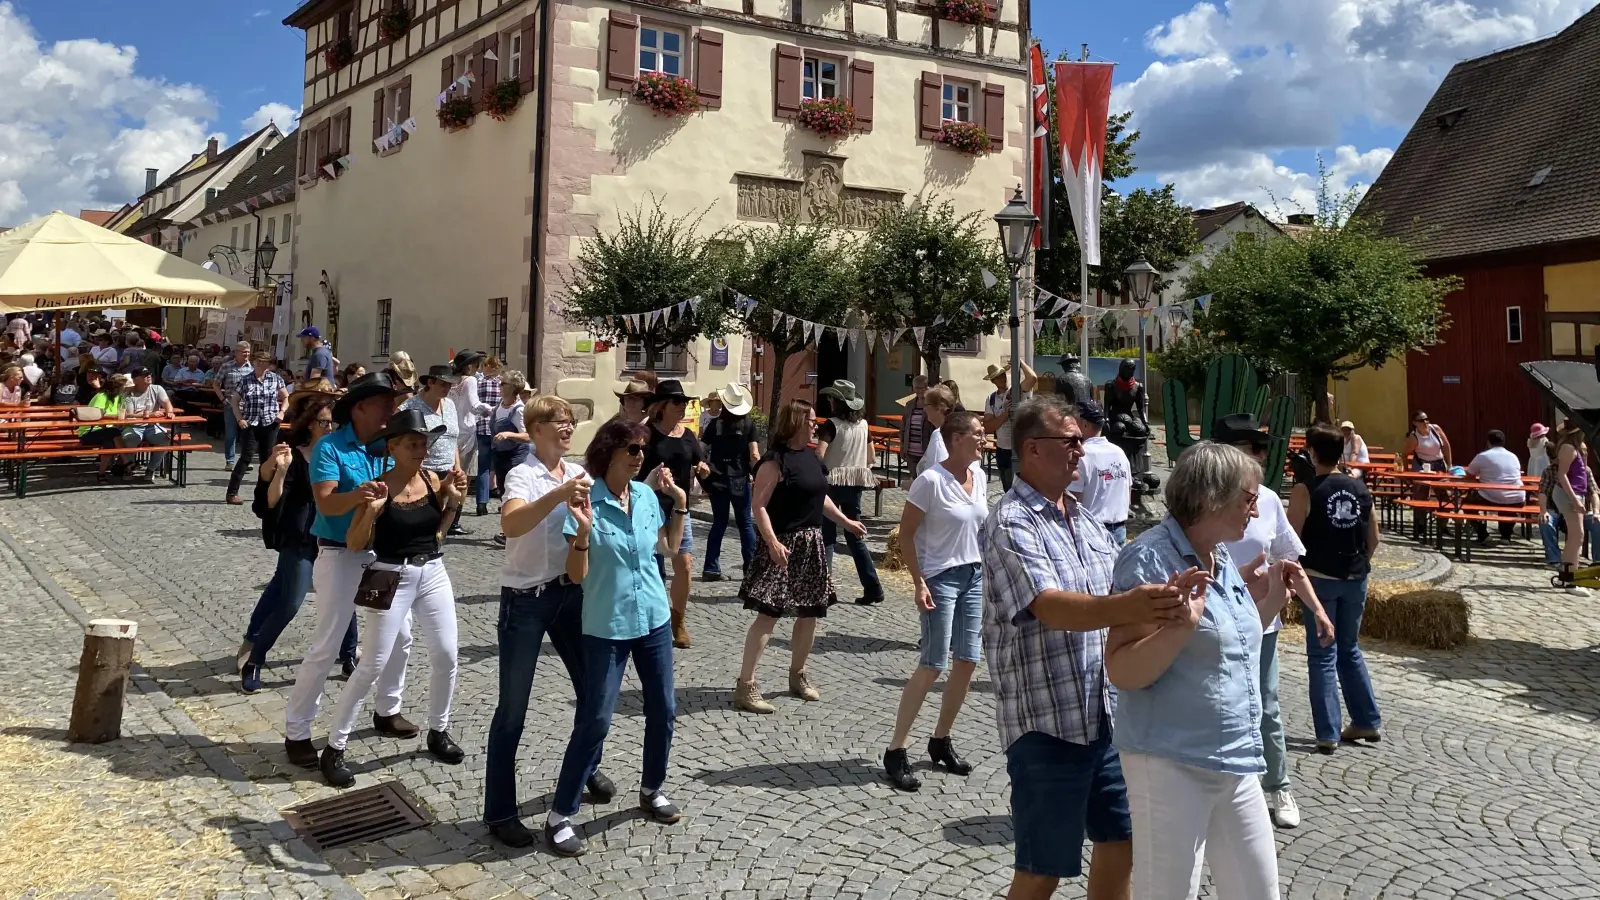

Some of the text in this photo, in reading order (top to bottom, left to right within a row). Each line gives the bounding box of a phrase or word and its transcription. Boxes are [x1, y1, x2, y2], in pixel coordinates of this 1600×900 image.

[35, 292, 219, 308] Das fröhliche Bier vom Land.
